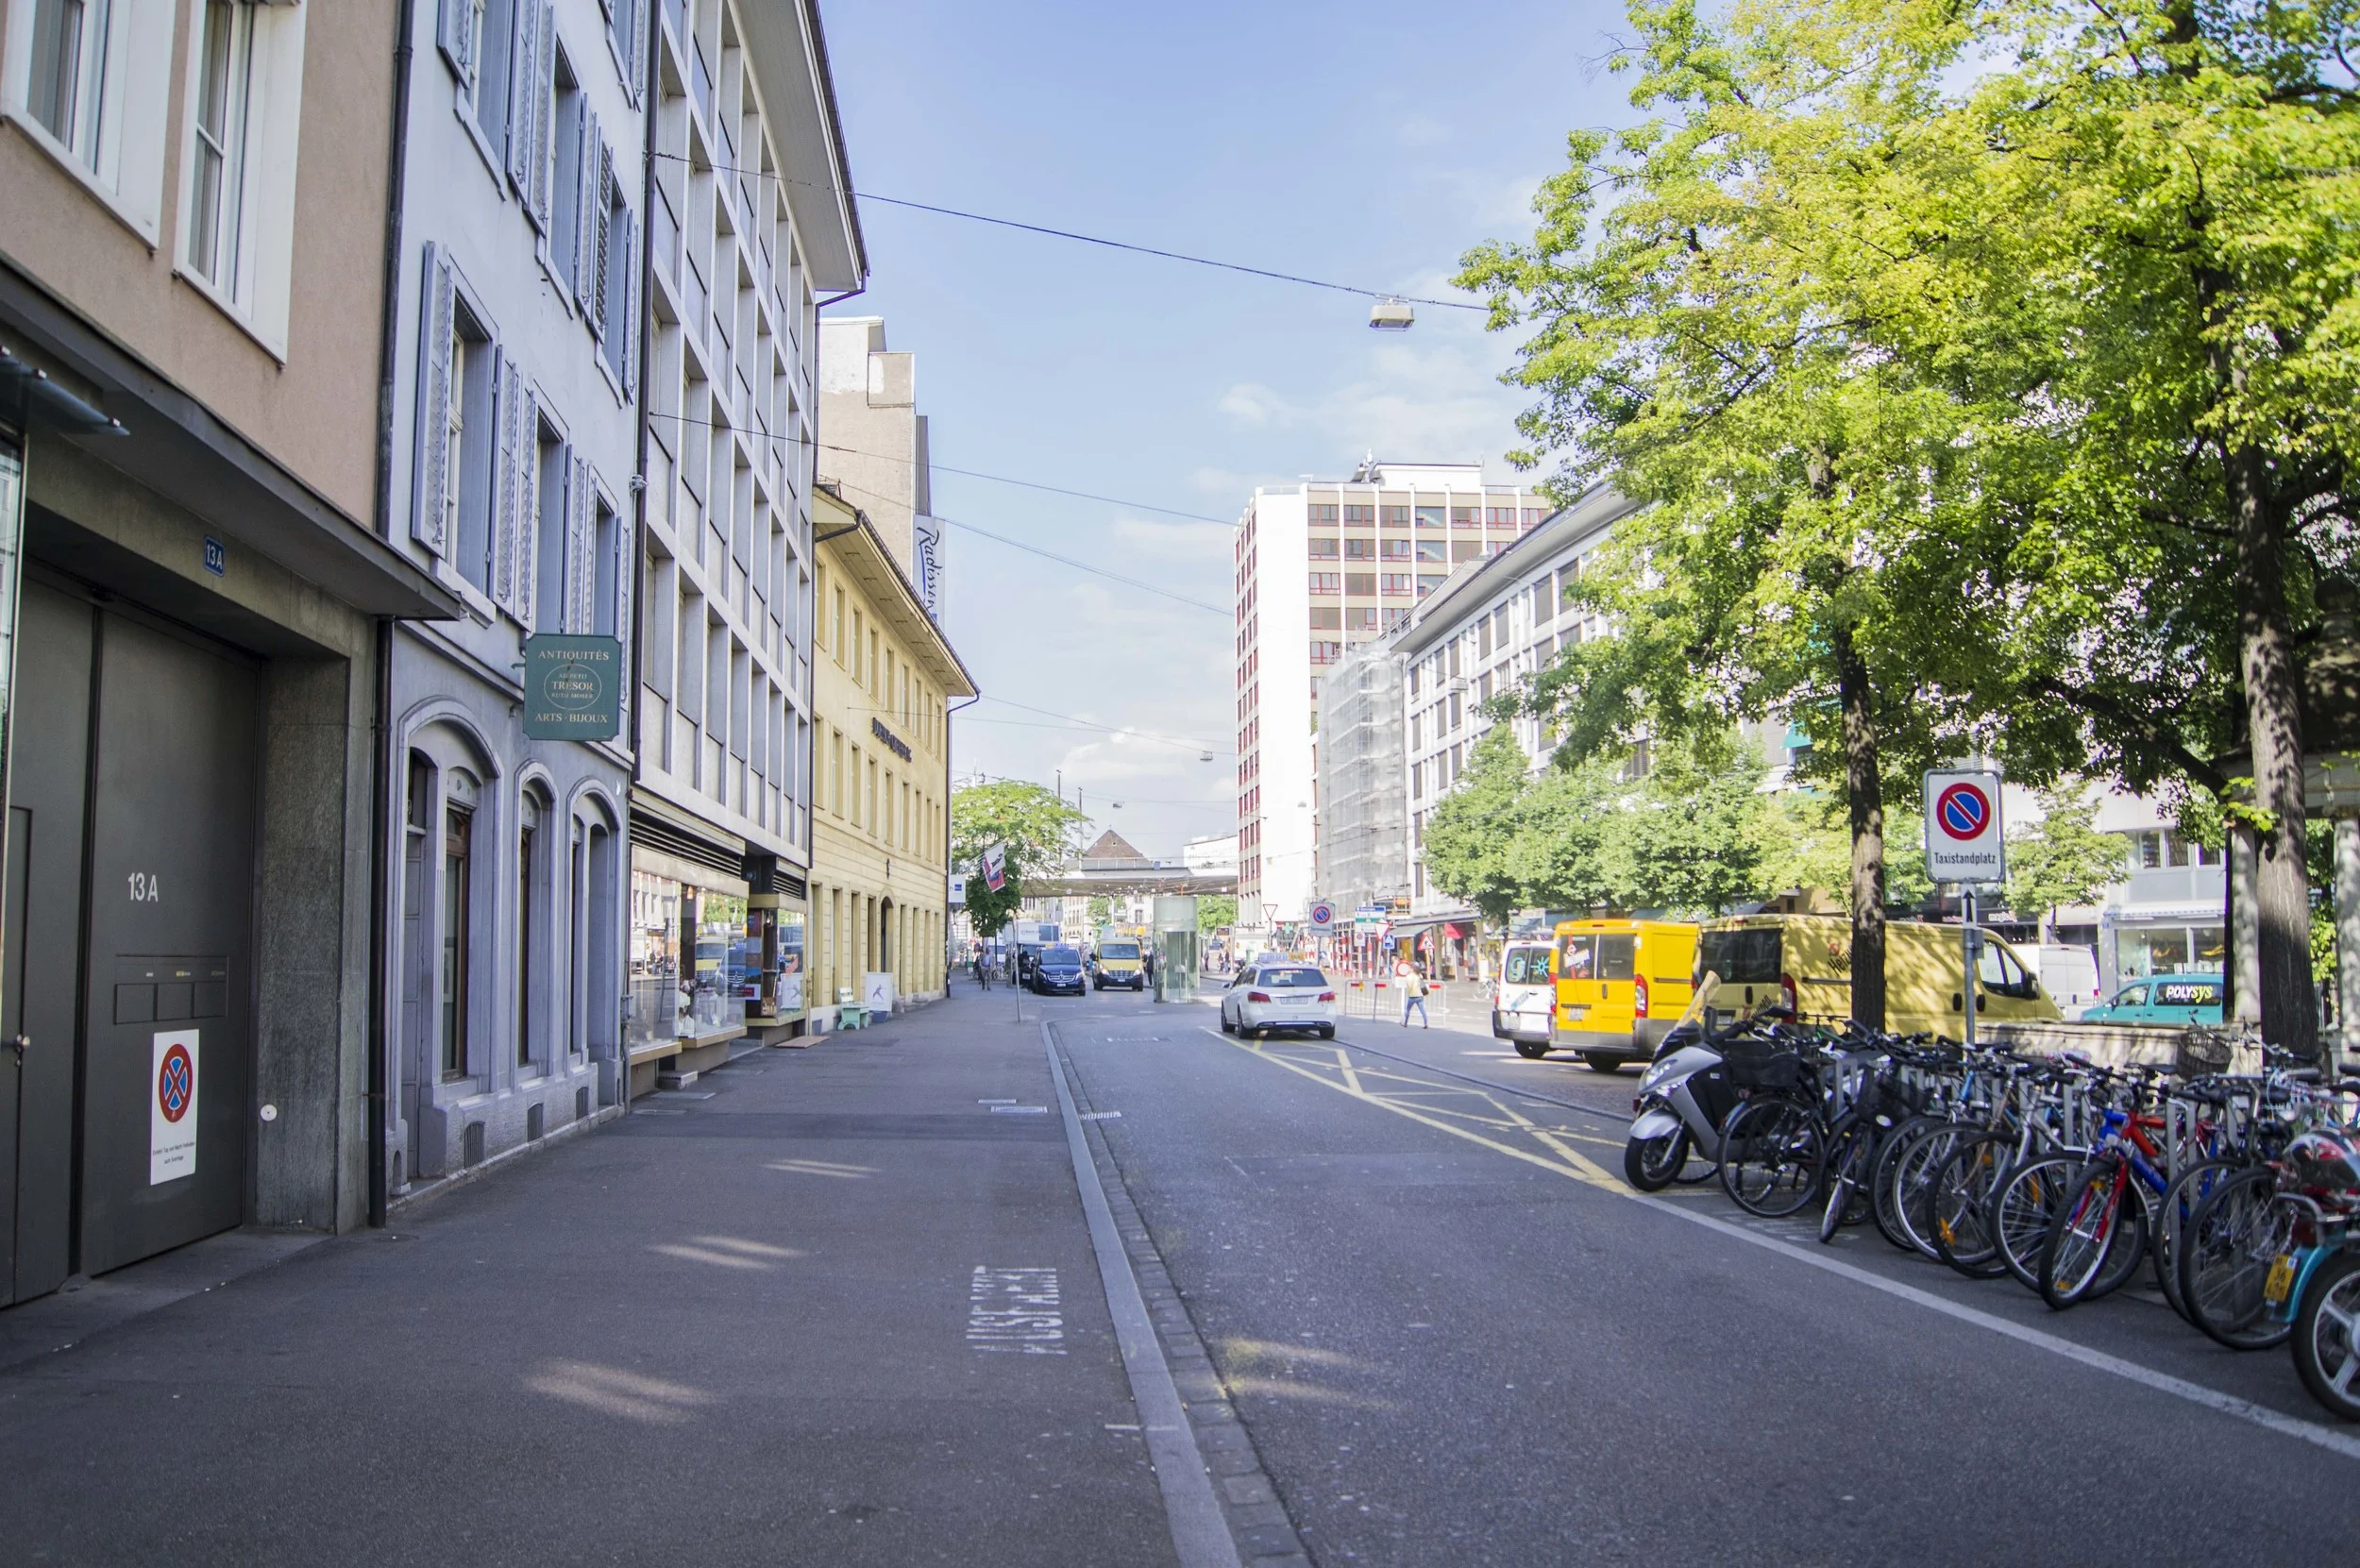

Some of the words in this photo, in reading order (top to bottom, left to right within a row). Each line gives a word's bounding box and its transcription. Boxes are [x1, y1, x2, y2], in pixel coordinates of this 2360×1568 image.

[916, 527, 943, 610] Radisson
[538, 649, 609, 661] ANTIQUITÉS
[534, 713, 563, 722] ARTS
[569, 713, 608, 723] BIJOUX
[1934, 852, 1997, 867] Taxistandplatz
